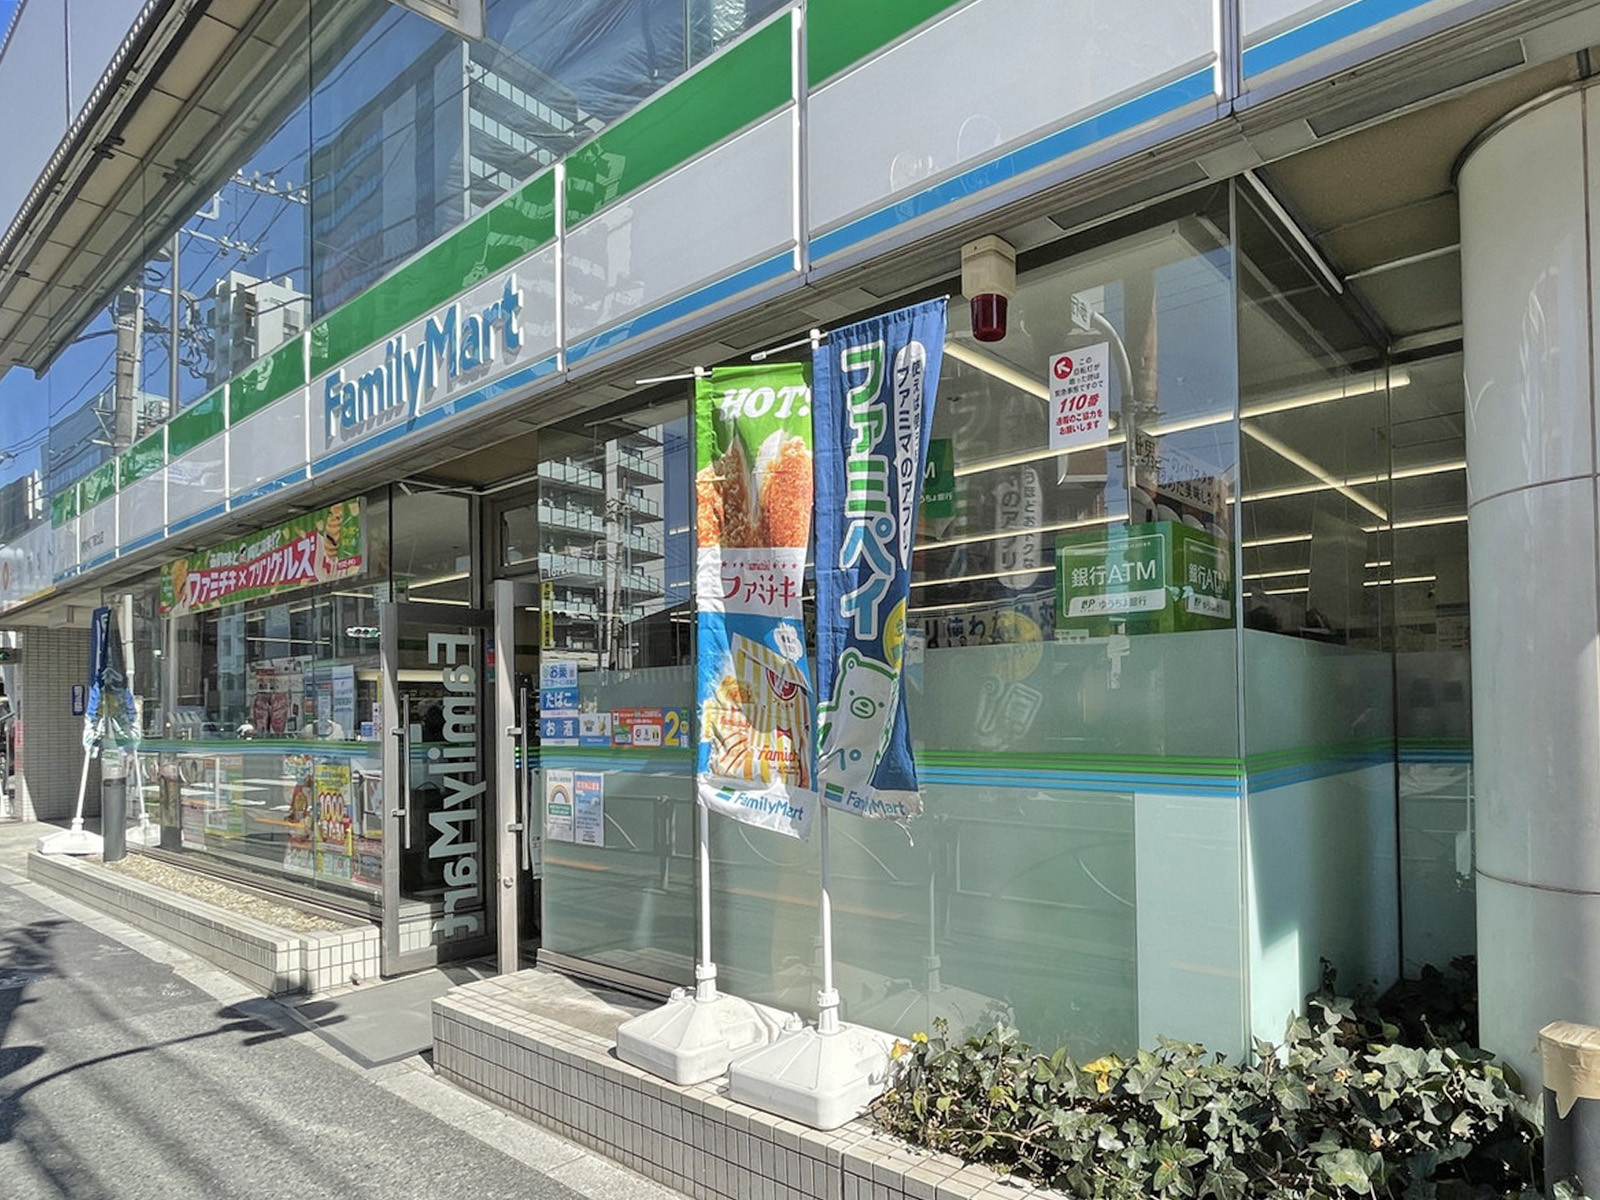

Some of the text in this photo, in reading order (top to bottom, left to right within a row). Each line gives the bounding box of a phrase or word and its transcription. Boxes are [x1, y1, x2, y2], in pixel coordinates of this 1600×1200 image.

[325, 272, 524, 438] FamilyMart
[1079, 355, 1092, 366] この
[1060, 393, 1100, 413] 110番
[1059, 420, 1100, 435] お願いします
[839, 339, 896, 640] ファミペイ
[1071, 560, 1156, 588] 銀行ATM
[721, 573, 797, 608] ファミチキ
[545, 692, 573, 708] たばこ
[545, 720, 574, 737] お酒
[664, 711, 680, 746] 2
[733, 792, 804, 821] FamilyMart
